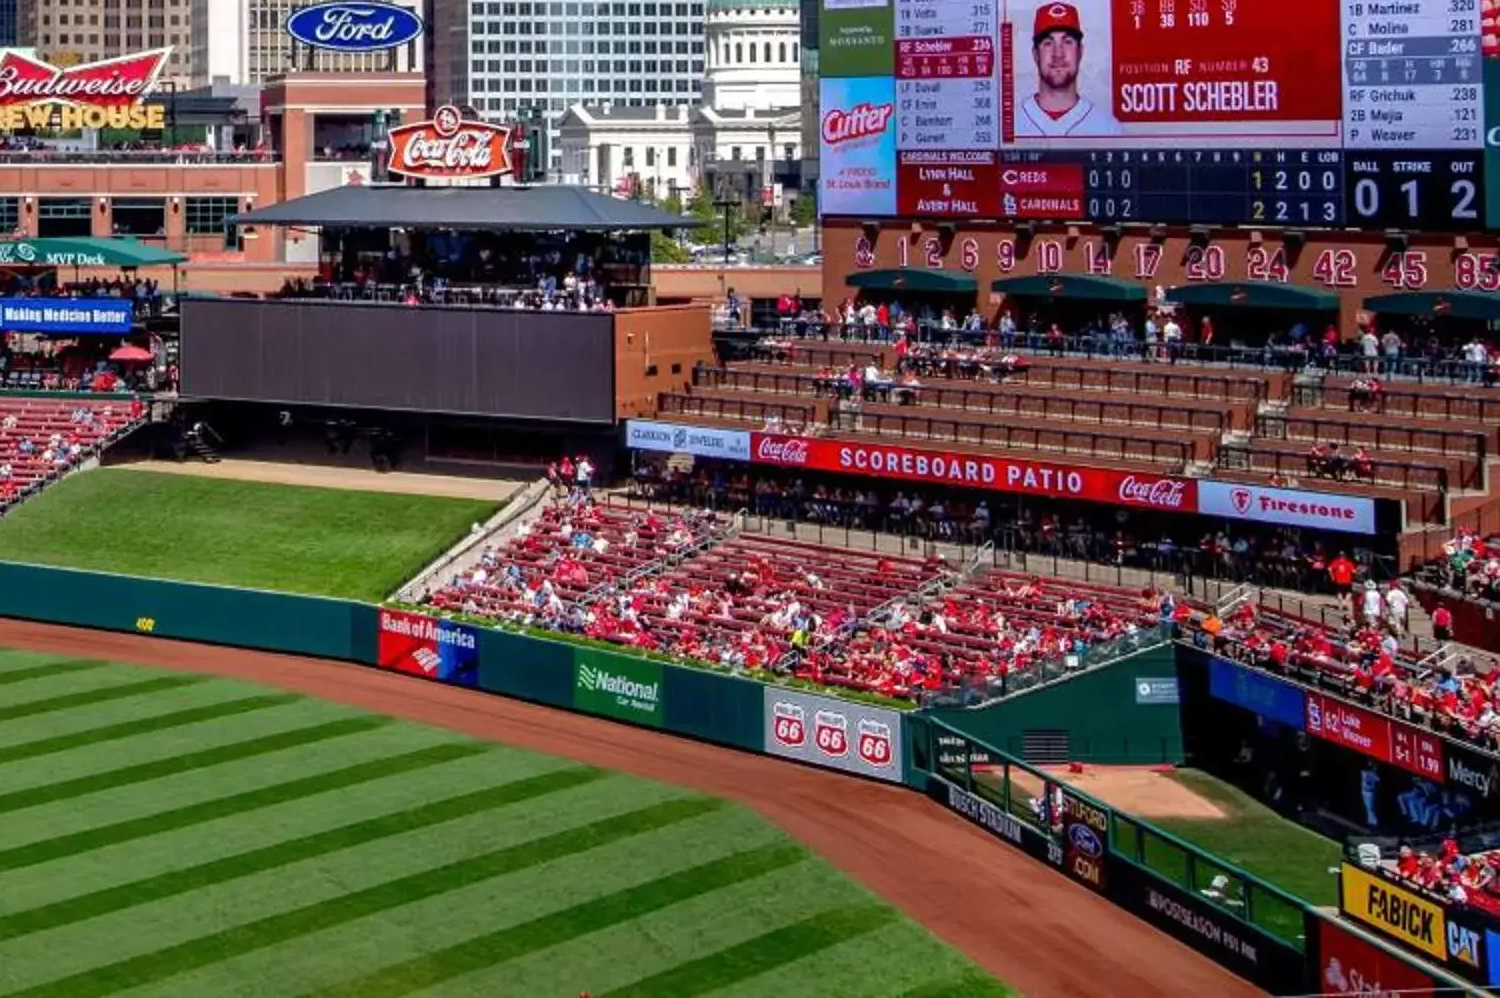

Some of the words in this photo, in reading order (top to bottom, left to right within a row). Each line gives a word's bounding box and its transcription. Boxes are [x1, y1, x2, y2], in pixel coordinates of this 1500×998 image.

[1349, 4, 1363, 16] 1B
[1368, 2, 1421, 15] Martinez
[315, 8, 394, 41] Ford
[1133, 15, 1140, 30] 1
[1159, 14, 1174, 29] 38
[1187, 12, 1209, 27] 110
[1225, 11, 1233, 26] 5
[1348, 23, 1357, 36] C
[1368, 22, 1408, 34] Molina
[1450, 19, 1474, 33] .281
[1349, 42, 1364, 55] CF
[1368, 41, 1404, 54] Bader
[1120, 62, 1169, 74] POSITION
[1175, 58, 1192, 75] RF
[1252, 57, 1269, 73] 43
[1121, 83, 1178, 112] SCOTT
[1184, 80, 1278, 111] SCHEBLER
[1370, 88, 1416, 102] Grichuk
[1451, 87, 1477, 101] .238
[61, 104, 166, 130] HOUSE
[823, 103, 892, 141] Cutter
[1350, 109, 1366, 122] 2B
[1351, 130, 1359, 142] P
[1372, 129, 1416, 141] Weaver
[1451, 128, 1477, 141] .231
[404, 130, 496, 168] Coca-Cola
[948, 168, 975, 181] HALL
[1353, 161, 1380, 172] BALL
[1392, 161, 1432, 173] STRIKE
[1450, 161, 1476, 173] OUT
[1019, 171, 1047, 182] REDS
[1089, 171, 1099, 188] 0
[1106, 171, 1113, 188] 1
[1121, 171, 1131, 188] 0
[1253, 171, 1262, 189] 1
[1276, 171, 1288, 189] 2
[1299, 172, 1311, 189] 0
[1323, 172, 1335, 190] 0
[951, 200, 978, 213] HALL
[1355, 178, 1379, 217] 0
[1401, 180, 1418, 217] 1
[1450, 179, 1478, 219] 2
[1020, 199, 1079, 211] CARDINALS
[1089, 199, 1099, 216] 0
[1106, 199, 1115, 216] 0
[1122, 200, 1131, 217] 2
[1253, 202, 1265, 219] 2
[1276, 202, 1288, 220] 2
[1300, 202, 1309, 220] 1
[1323, 203, 1336, 221] 3
[46, 254, 75, 265] MVP
[77, 253, 106, 265] Deck
[898, 237, 909, 267] 1
[925, 237, 943, 268] 2
[960, 239, 979, 271] 6
[997, 240, 1015, 271] 9
[1036, 240, 1062, 274] 10
[1083, 242, 1111, 275] 14
[1135, 243, 1164, 277] 17
[1187, 246, 1225, 279] 20
[1247, 248, 1289, 282] 24
[1313, 250, 1357, 285] 42
[1382, 251, 1427, 287] 45
[1455, 254, 1500, 290] 85
[4, 308, 41, 323] Making
[43, 309, 90, 323] Medicine
[93, 309, 126, 323] Better
[759, 437, 807, 463] Coca-Cola
[839, 447, 997, 483] SCOREBOARD
[1007, 463, 1083, 494] PATIO
[1118, 475, 1186, 507] Coca-Cola
[1258, 494, 1356, 520] Firestone
[382, 612, 411, 635] Bank
[411, 620, 425, 638] of
[425, 621, 476, 649] America
[777, 720, 801, 740] 66
[1325, 710, 1338, 731] 62
[1342, 710, 1361, 730] Luke
[819, 729, 842, 750] 66
[862, 737, 887, 759] 66
[1449, 756, 1491, 798] Mercy
[950, 783, 979, 821] BUSCH
[979, 802, 1022, 844] STADIUM
[1367, 884, 1433, 945] FABICK
[1446, 921, 1480, 970] CAT
